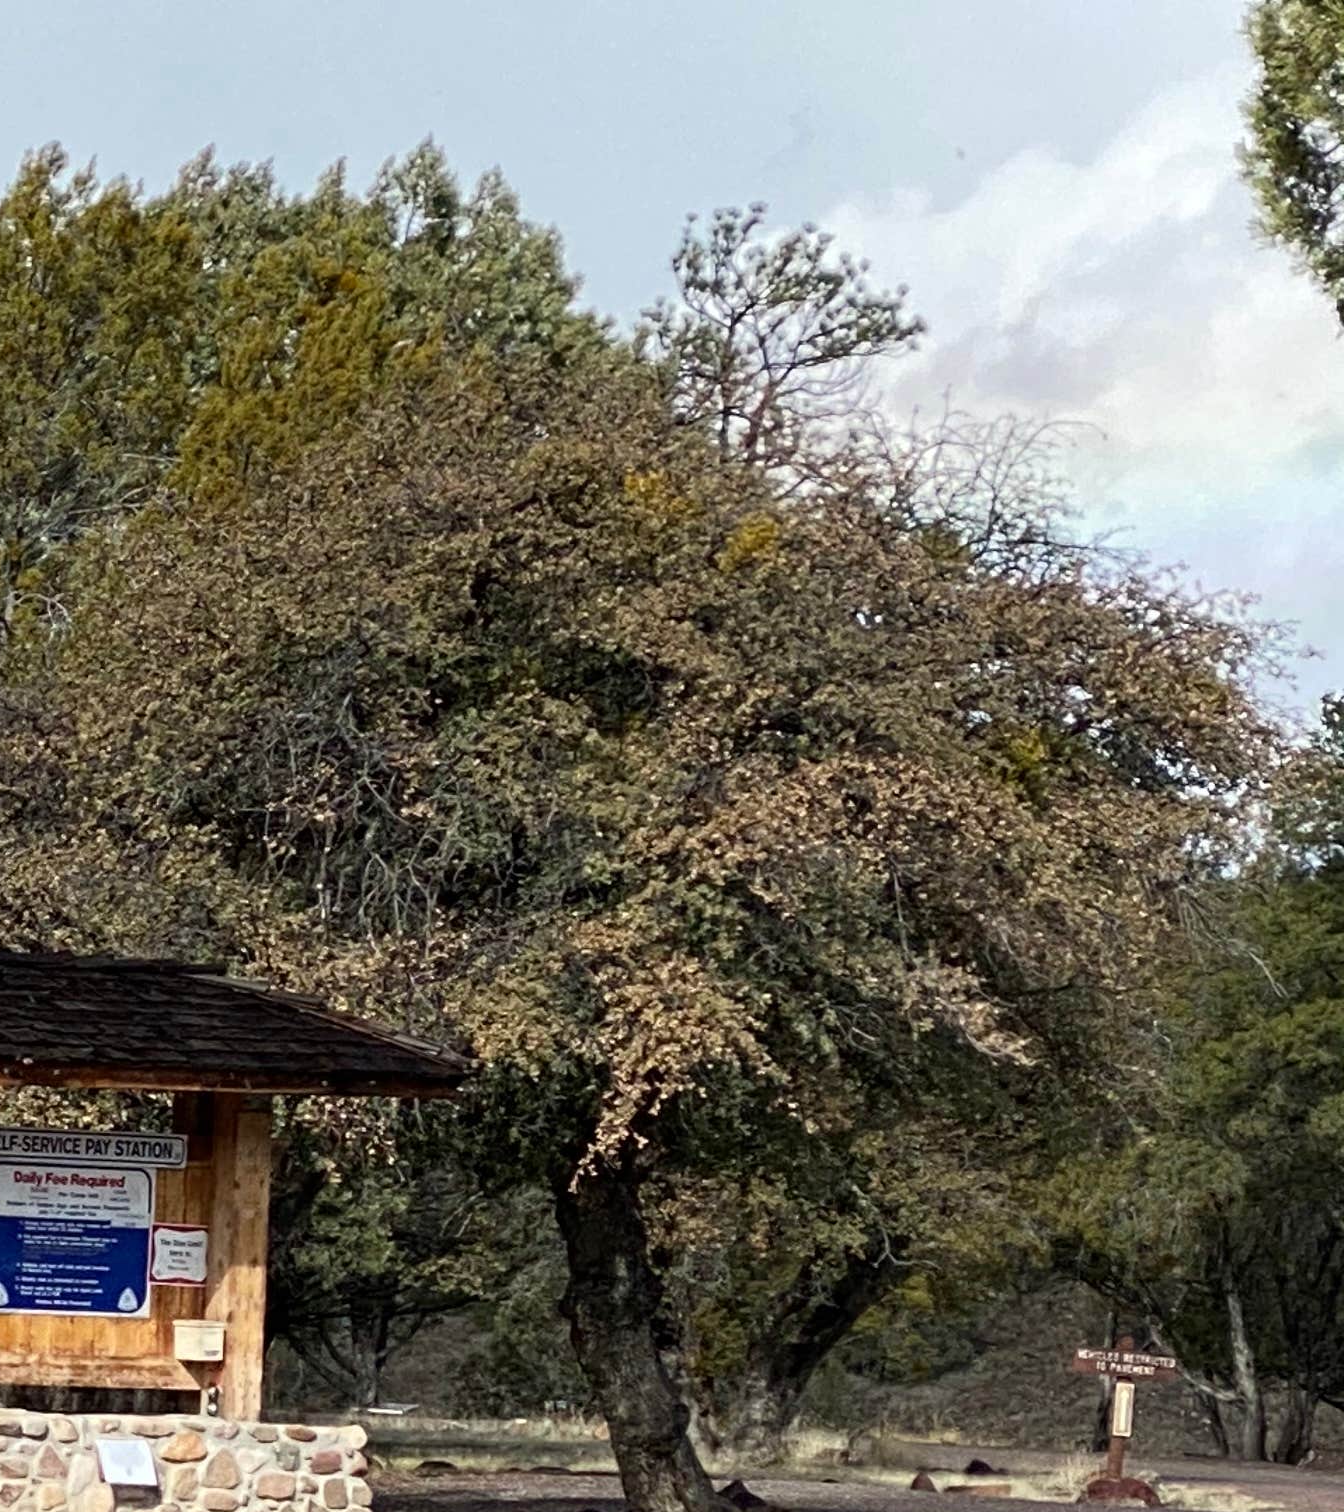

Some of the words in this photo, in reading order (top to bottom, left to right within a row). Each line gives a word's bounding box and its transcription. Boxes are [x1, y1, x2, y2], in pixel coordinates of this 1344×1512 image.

[85, 1138, 111, 1156] PAY
[115, 1139, 173, 1159] STATION
[14, 1171, 43, 1186] Daily
[45, 1172, 68, 1185] Fee
[71, 1173, 125, 1188] Required
